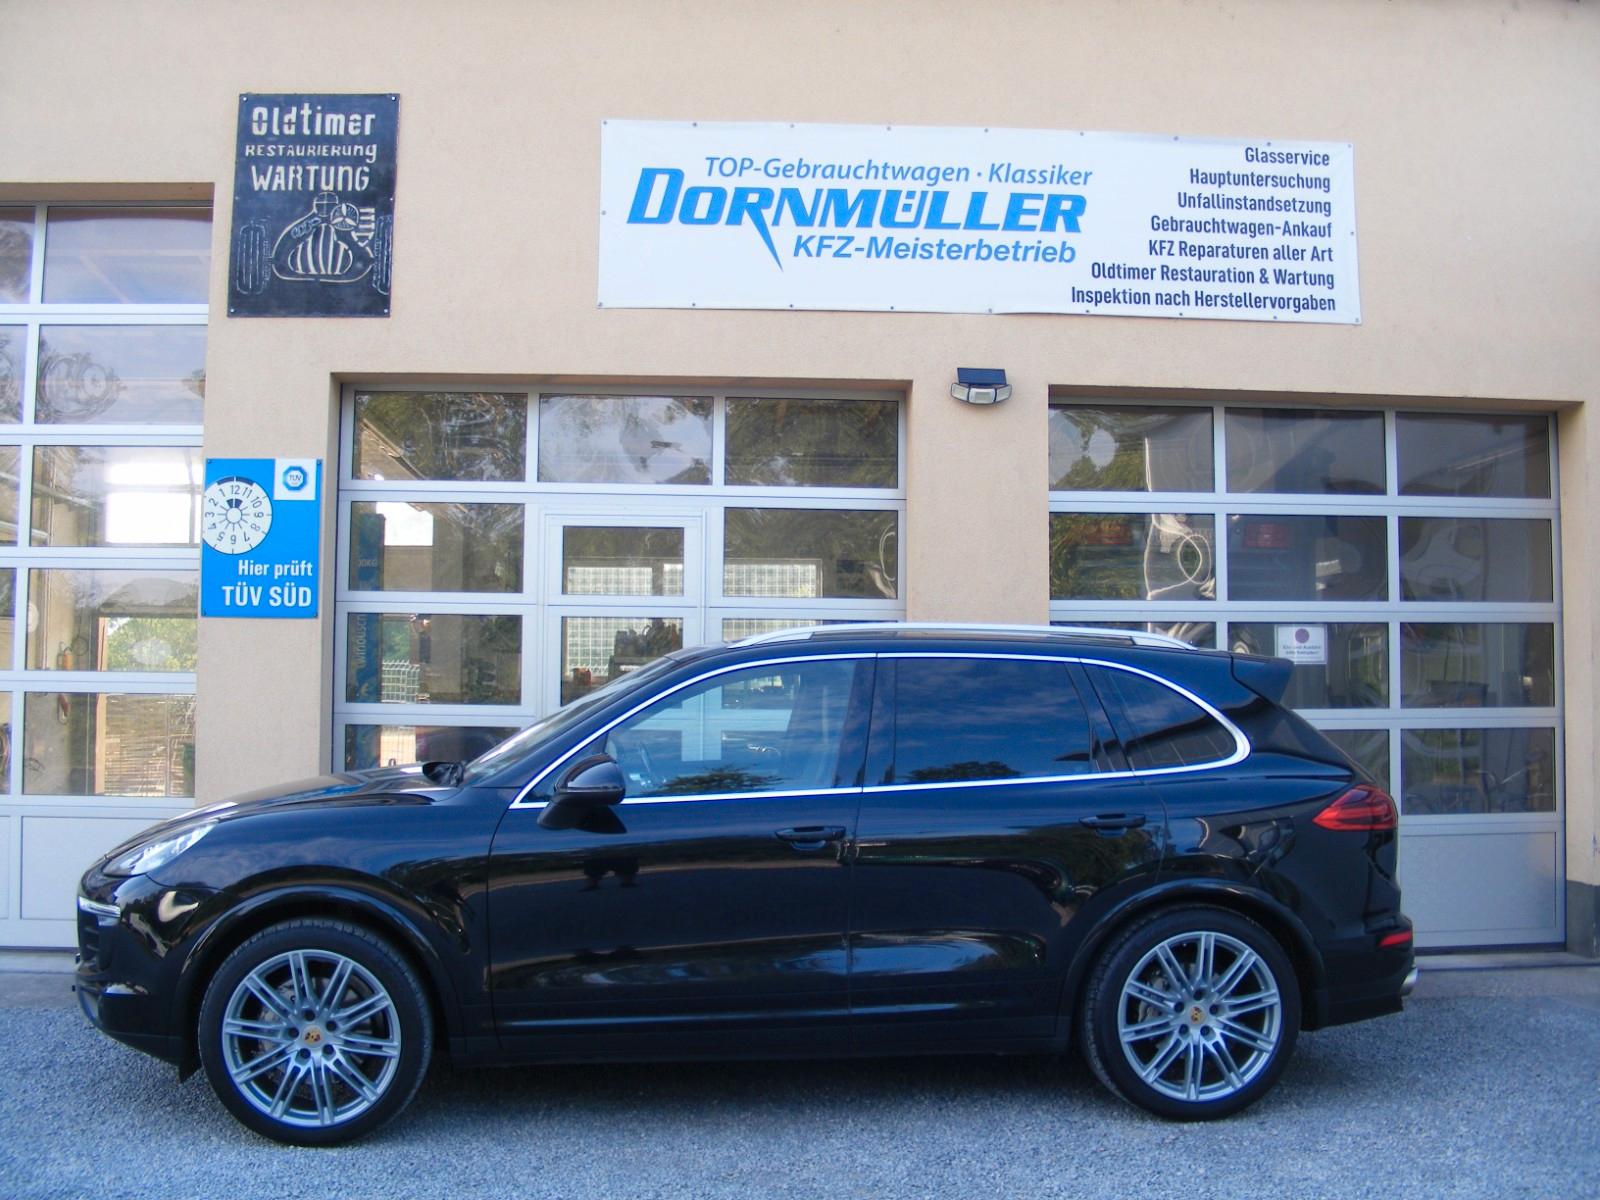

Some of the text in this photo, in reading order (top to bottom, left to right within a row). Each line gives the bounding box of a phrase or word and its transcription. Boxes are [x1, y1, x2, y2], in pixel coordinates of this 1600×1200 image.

[252, 102, 376, 136] Oldtimer
[1245, 147, 1331, 167] Glasservice
[705, 156, 970, 187] TOP-Gebrauchtwagen
[988, 163, 1094, 186] Klassiker
[1190, 168, 1331, 194] Hauptuntersuchung
[1178, 192, 1332, 218] Unfallinstandsetzung
[1151, 215, 1333, 239] Gebrauchtwagen-Ankauf
[793, 235, 1077, 264] KFZ-Meisterbetrieb
[1148, 240, 1334, 263] KFZ Reparaturen aller Art
[1091, 262, 1335, 291] Oldtimer Restauration & Wartung
[1071, 286, 1336, 314] Inspektion nach Herstellervorgaben
[230, 484, 241, 495] 12
[238, 559, 313, 580] Hier prüft
[222, 581, 312, 607] TÜV SÜD
